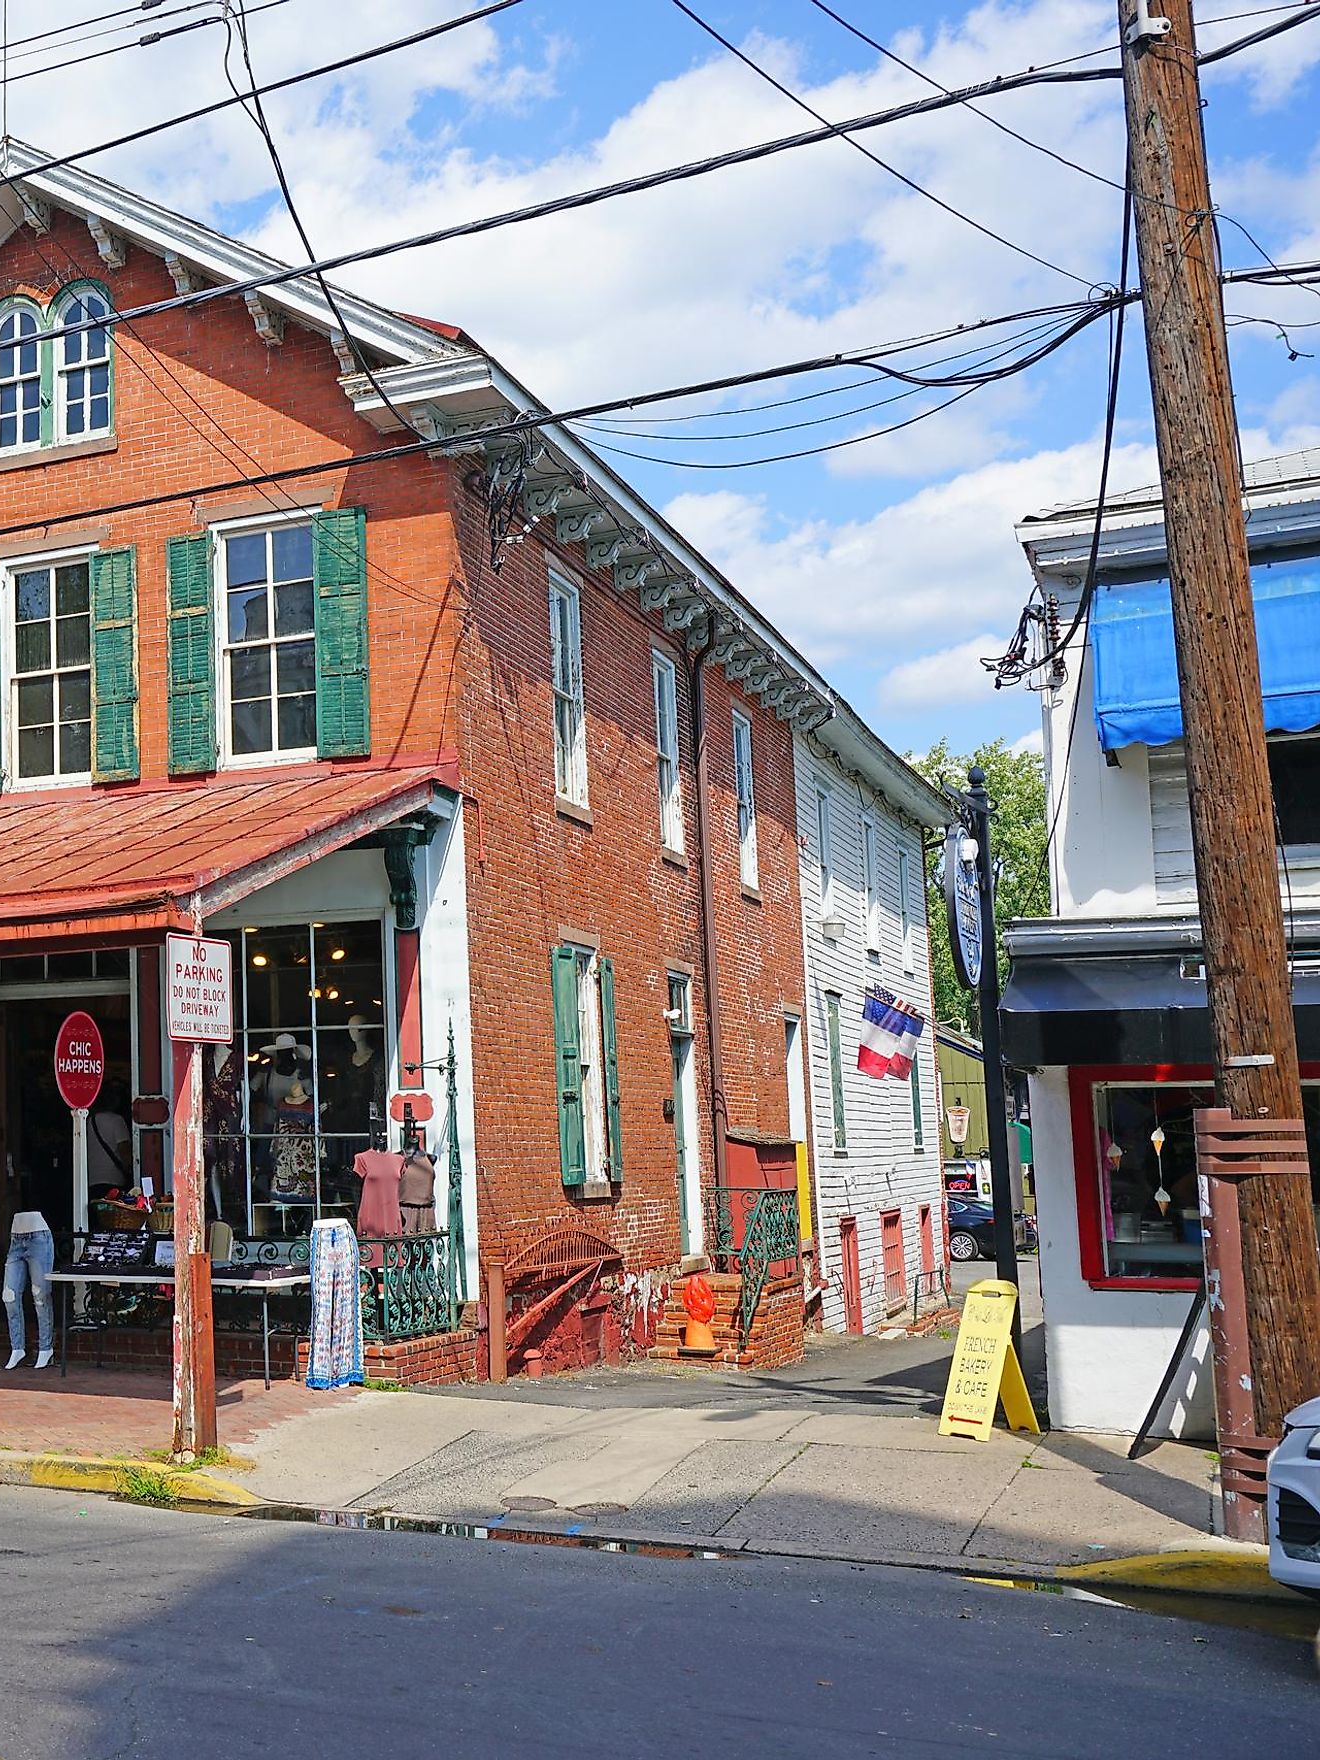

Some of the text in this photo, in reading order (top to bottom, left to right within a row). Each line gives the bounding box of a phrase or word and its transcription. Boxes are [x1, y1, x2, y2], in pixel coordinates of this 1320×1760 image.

[192, 946, 207, 963] NO
[175, 963, 223, 983] PARKING
[173, 985, 226, 1003] DO NOT BLOCK
[181, 1002, 220, 1018] DRIVEWAY
[204, 1023, 210, 1034] BE
[68, 1041, 92, 1057] CHIC
[58, 1058, 102, 1074] HAPPENS
[948, 1182, 971, 1190] OPEN
[963, 1336, 997, 1354] FRENCH
[959, 1357, 993, 1375] BAKERY
[963, 1380, 988, 1398] CAFE
